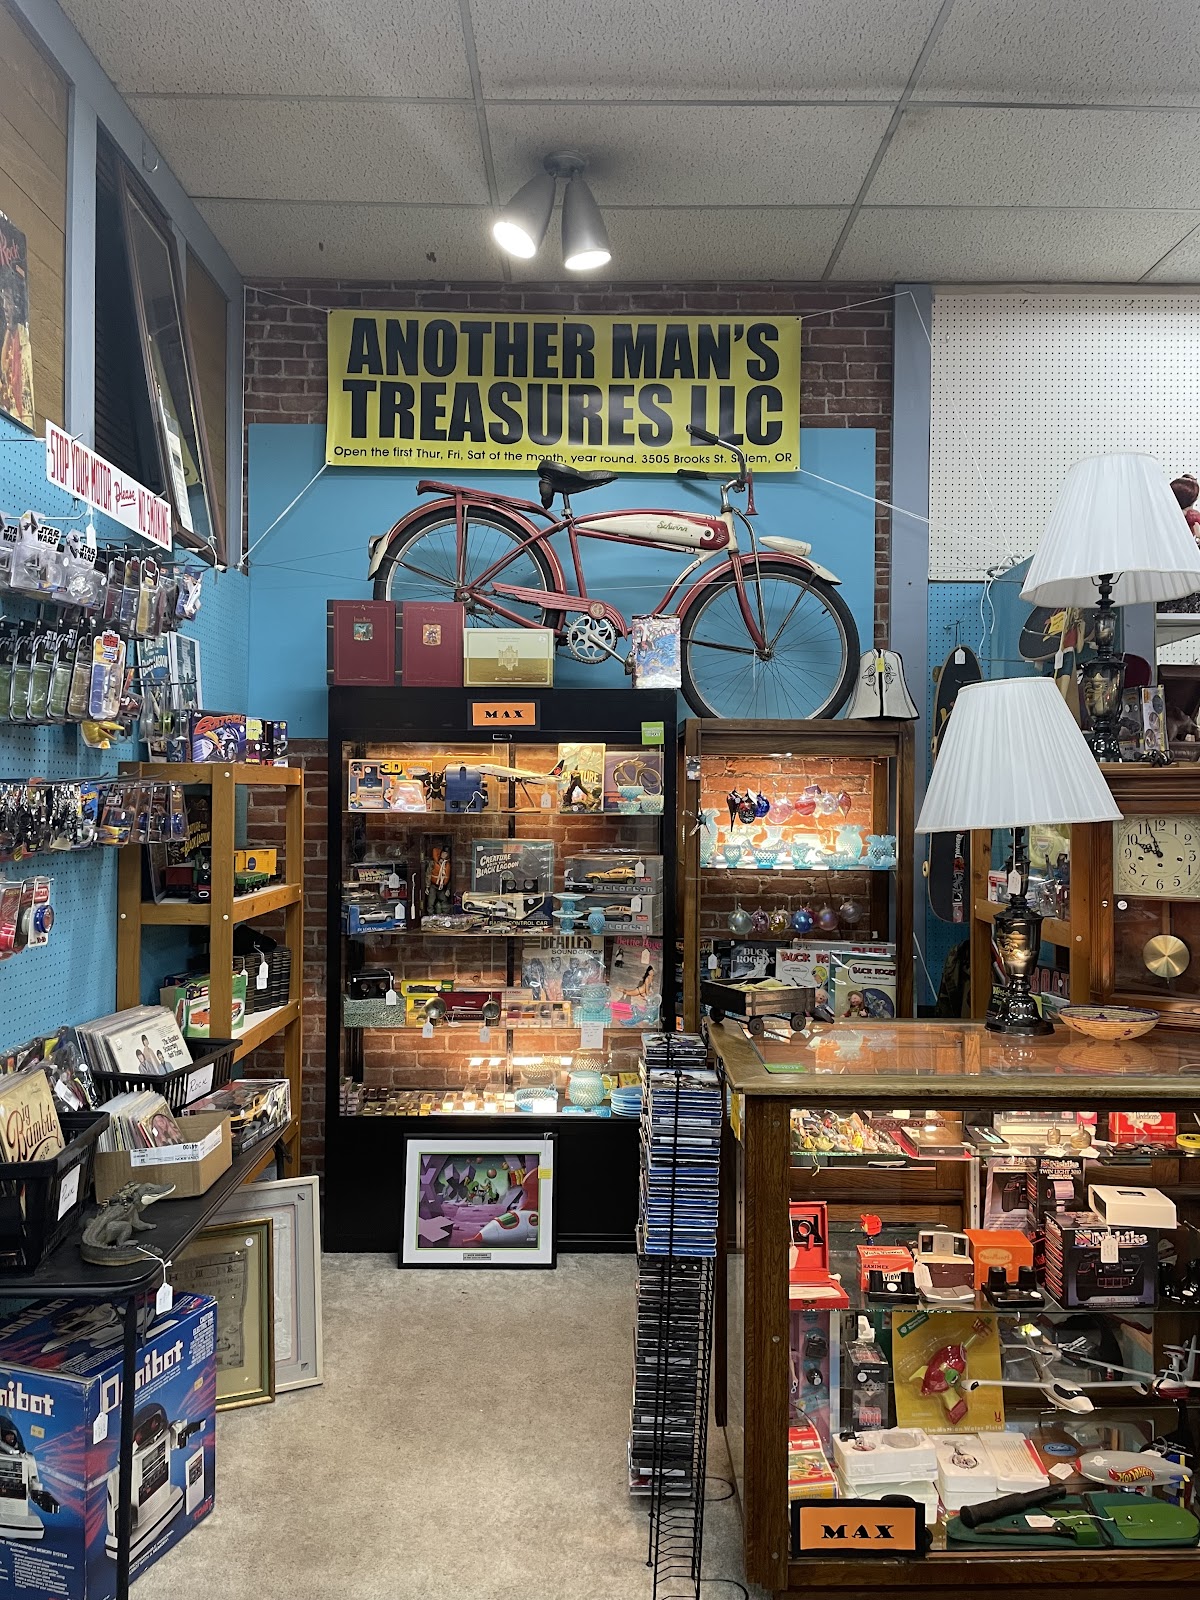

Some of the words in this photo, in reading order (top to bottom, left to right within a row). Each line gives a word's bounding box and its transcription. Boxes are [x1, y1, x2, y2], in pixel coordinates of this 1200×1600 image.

[346, 317, 596, 379] ANOTHER
[611, 321, 780, 382] MAN'S
[342, 379, 673, 447] TREASURES
[689, 384, 784, 446] LLC
[334, 446, 367, 458] Open
[371, 446, 389, 457] the
[393, 446, 413, 457] first
[416, 448, 443, 460] Thur,
[447, 449, 463, 461] Fri,
[467, 450, 486, 460] Sat
[489, 450, 501, 460] of
[504, 451, 523, 461] the
[526, 452, 567, 464] month,
[570, 454, 596, 466] year
[600, 454, 637, 464] round.
[641, 454, 670, 464] 3505
[674, 454, 710, 464] Brooks
[713, 454, 727, 464] St.
[775, 452, 792, 463] OR
[51, 429, 69, 486] STOP
[72, 444, 89, 501] YOUR
[91, 455, 112, 512] MOTOR
[114, 476, 136, 514] Please
[138, 487, 146, 532] NO
[147, 494, 169, 546] SMOKING
[4, 525, 17, 535] STA
[38, 526, 60, 537] STAR
[657, 521, 687, 532] Schwinn
[37, 534, 59, 545] WARS
[80, 544, 96, 555] STAR
[80, 552, 95, 563] WARS
[484, 709, 525, 719] MAX
[380, 761, 402, 775] 3D
[1139, 823, 1148, 834] 11
[1155, 819, 1166, 831] 12
[1174, 823, 1178, 835] 1
[1127, 834, 1138, 845] 10
[1184, 834, 1192, 845] 2
[1124, 848, 1132, 860] 9
[1189, 850, 1196, 862] 3
[480, 854, 511, 867] CREATURE
[475, 866, 497, 879] BLACK
[496, 860, 520, 873] LAGOON
[1128, 863, 1137, 875] 8
[1184, 864, 1191, 876] 4
[1141, 874, 1149, 885] 7
[1156, 879, 1164, 890] 6
[1173, 876, 1180, 887] 5
[743, 948, 770, 957] BUCK
[780, 952, 811, 963] BUCK
[852, 967, 873, 975] BUCK
[1049, 1160, 1079, 1168] Nishika
[1118, 1472, 1132, 1483] HOT
[1132, 1467, 1153, 1480] WHEELS
[821, 1524, 895, 1539] MAX
